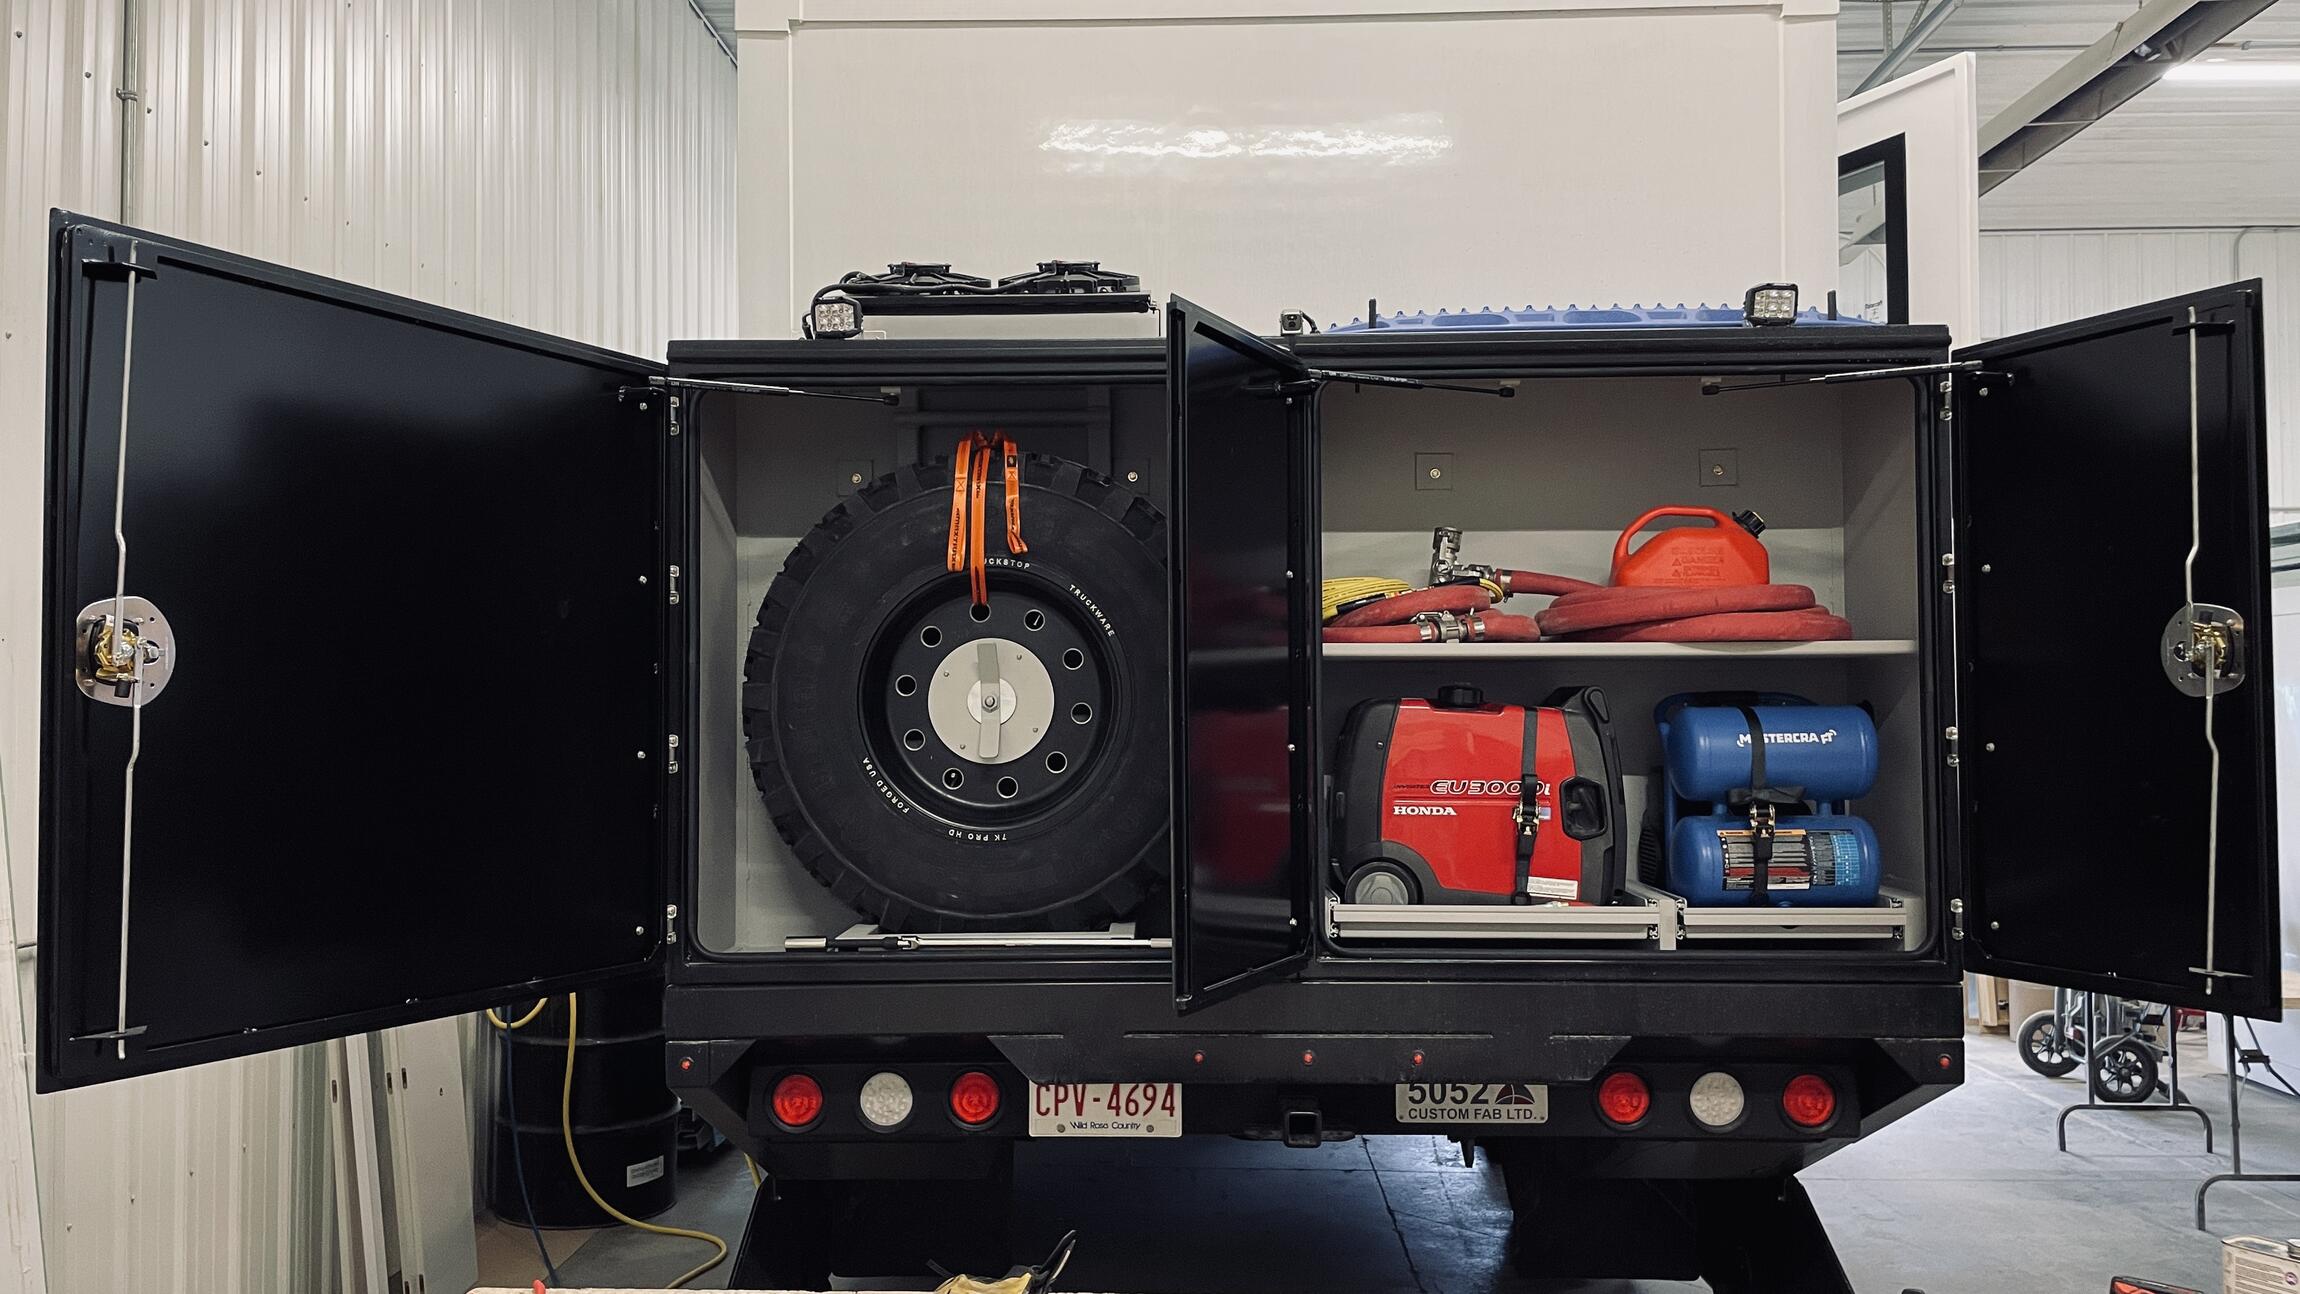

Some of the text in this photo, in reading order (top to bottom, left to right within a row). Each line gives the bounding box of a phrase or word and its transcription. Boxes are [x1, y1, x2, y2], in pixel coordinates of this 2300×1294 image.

[1069, 584, 1115, 637] TRUCKWARE
[1739, 732, 1833, 745] MSTERCRAFT
[862, 757, 910, 813] FORGED USA
[1393, 806, 1457, 816] HONDA
[948, 829, 963, 838] HD
[967, 833, 989, 842] PRO
[1036, 1083, 1176, 1117] CPV-4694
[1408, 1083, 1489, 1105] 5052
[1408, 1108, 1537, 1120] CUSTOM FAB LTD.
[1070, 1121, 1087, 1129] Wild
[1111, 1121, 1140, 1130] Country
